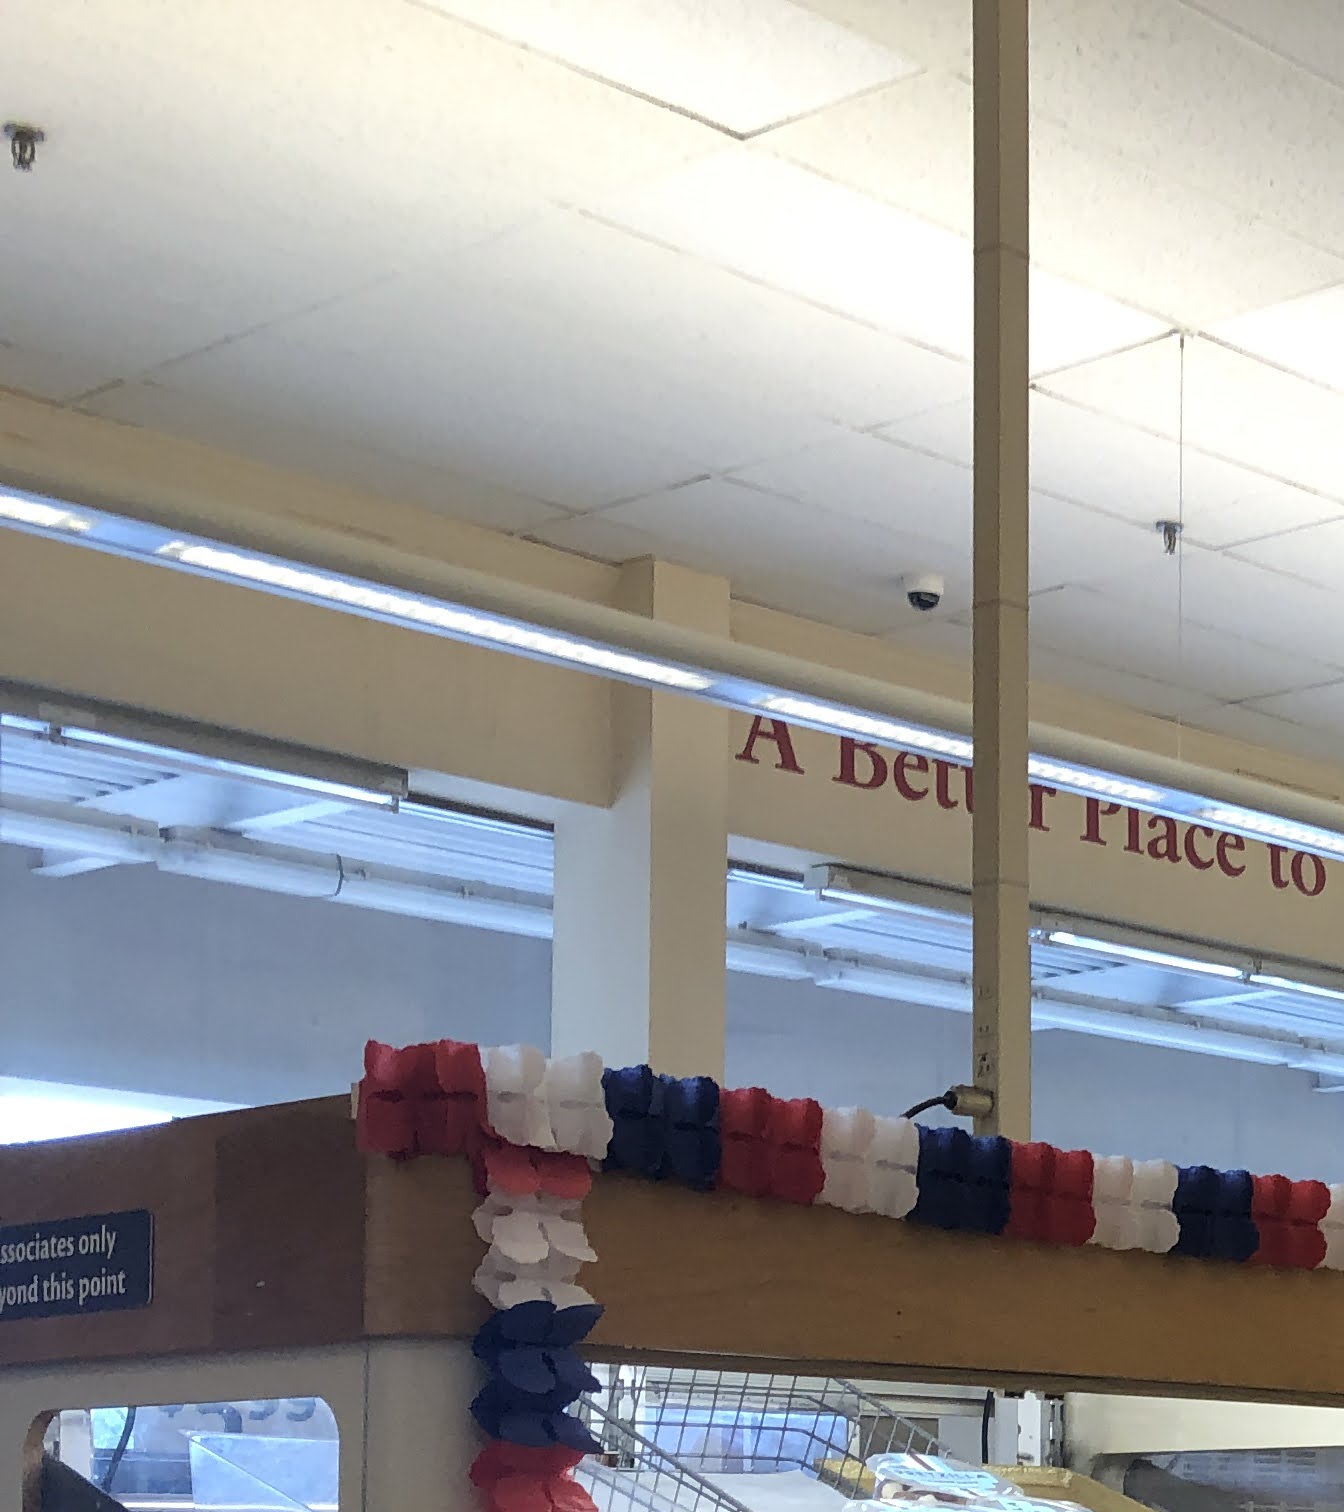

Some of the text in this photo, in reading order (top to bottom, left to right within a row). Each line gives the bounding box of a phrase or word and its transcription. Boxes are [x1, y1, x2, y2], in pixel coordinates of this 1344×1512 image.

[736, 712, 806, 775] A
[832, 733, 1049, 833] Bettr
[1265, 843, 1328, 898] to
[0, 1224, 117, 1265] ssociates only
[42, 1271, 75, 1302] this
[78, 1267, 126, 1306] point
